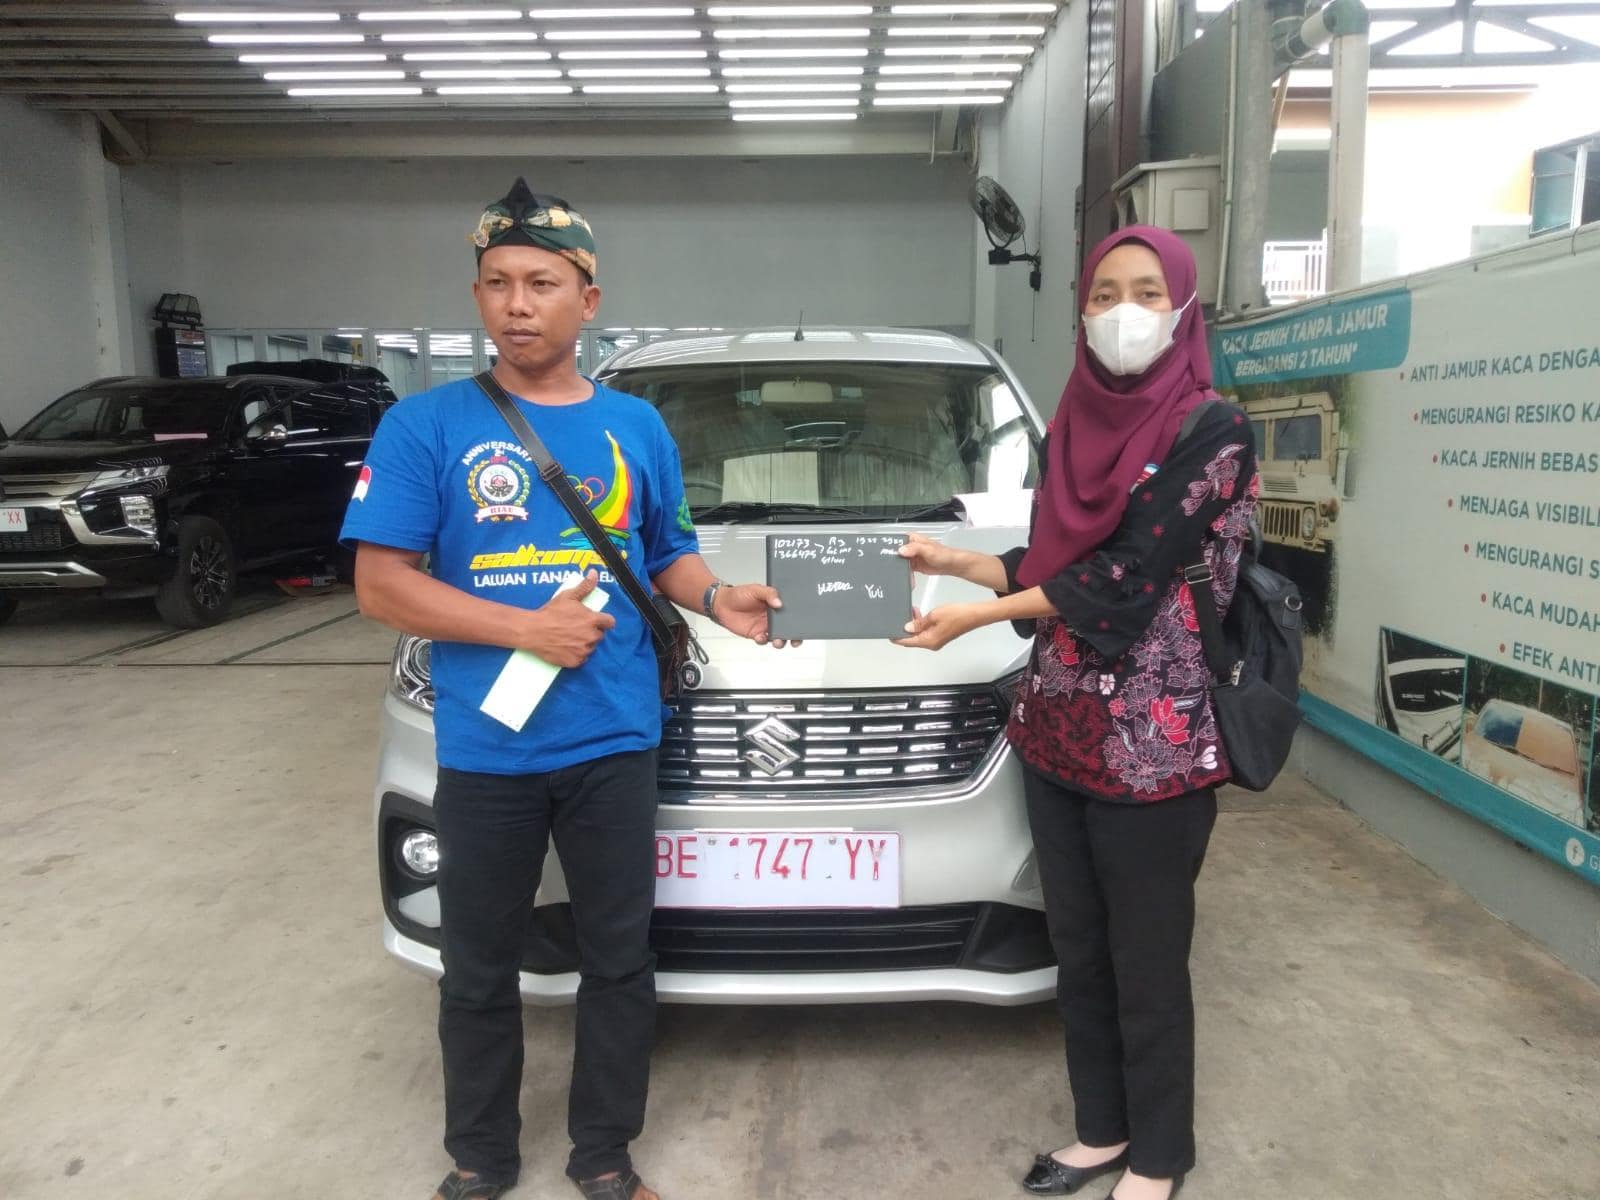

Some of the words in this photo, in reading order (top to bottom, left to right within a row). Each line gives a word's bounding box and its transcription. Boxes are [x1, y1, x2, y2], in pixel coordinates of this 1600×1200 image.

[1249, 327, 1289, 352] JERNIH
[1292, 316, 1333, 344] TANPA
[1337, 304, 1388, 334] JAMUR
[1235, 351, 1297, 377] BERGARANSI
[1300, 350, 1308, 369] 2
[1410, 364, 1438, 382] ANTI
[1441, 359, 1487, 380] JAMUR
[1491, 355, 1534, 376] KACA
[1421, 406, 1510, 425] MENGURANGI
[1515, 403, 1576, 423] RESIKO
[1441, 449, 1478, 467] KACA
[1482, 451, 1536, 471] JERNIH
[1540, 452, 1599, 473] BEBAS
[8, 511, 22, 525] XX
[1460, 495, 1530, 519] MENJAGA
[1476, 541, 1584, 577] MENGURANGI
[474, 572, 527, 588] LALUAN
[1492, 591, 1535, 618] KACA
[1513, 642, 1554, 671] EFEK
[655, 836, 698, 879] BE
[729, 837, 813, 881] 747
[845, 838, 886, 881] YY
